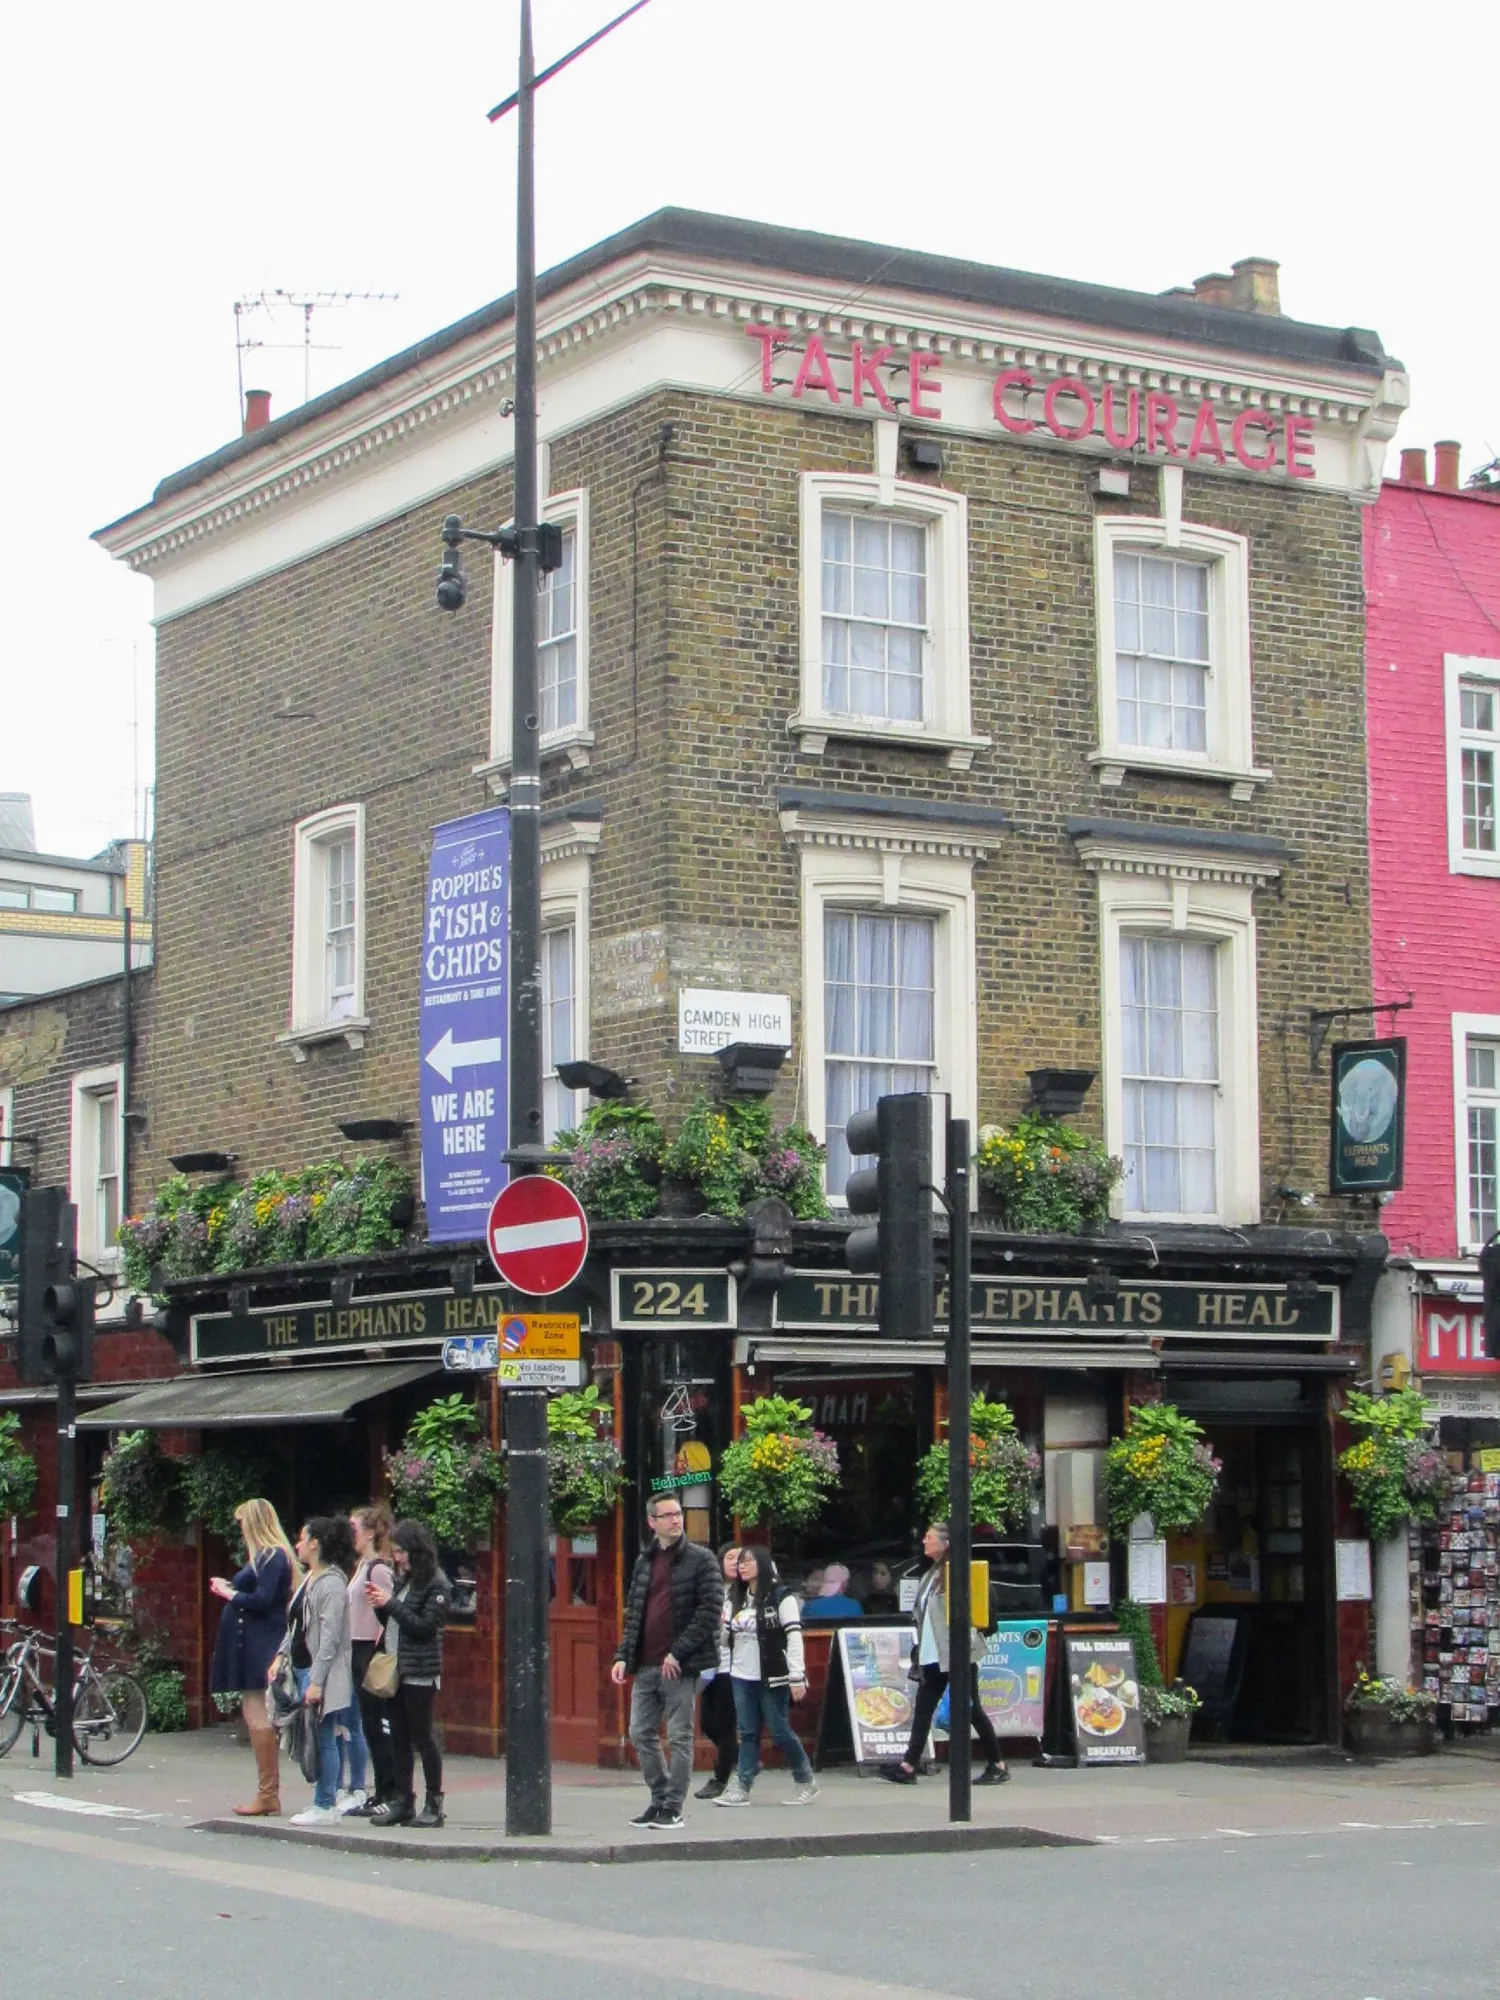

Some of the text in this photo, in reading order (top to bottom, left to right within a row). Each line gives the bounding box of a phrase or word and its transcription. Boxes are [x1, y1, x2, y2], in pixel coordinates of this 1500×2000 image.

[744, 323, 1316, 478] TAKE COURAGE
[431, 865, 502, 903] POPPIE'S
[427, 901, 502, 944] FISH &
[426, 939, 502, 981] CHIPS
[684, 1009, 781, 1030] CAMDEN HIGH
[684, 1029, 732, 1047] STREET
[431, 1088, 494, 1123] WE ARE
[443, 1124, 485, 1155] HERE
[632, 1282, 709, 1316] 224
[1198, 1294, 1300, 1326] HEAD
[263, 1296, 503, 1346] THE ELEPHANTS HEAD
[531, 1321, 576, 1329] Restricted
[544, 1331, 564, 1339] Zone
[530, 1348, 545, 1356] any
[547, 1346, 567, 1354] time
[519, 1362, 565, 1373] No loading
[651, 1472, 712, 1490] Heineken
[1071, 1641, 1130, 1652] FULL ENGLISH
[1087, 1746, 1137, 1756] BREAKFAST
